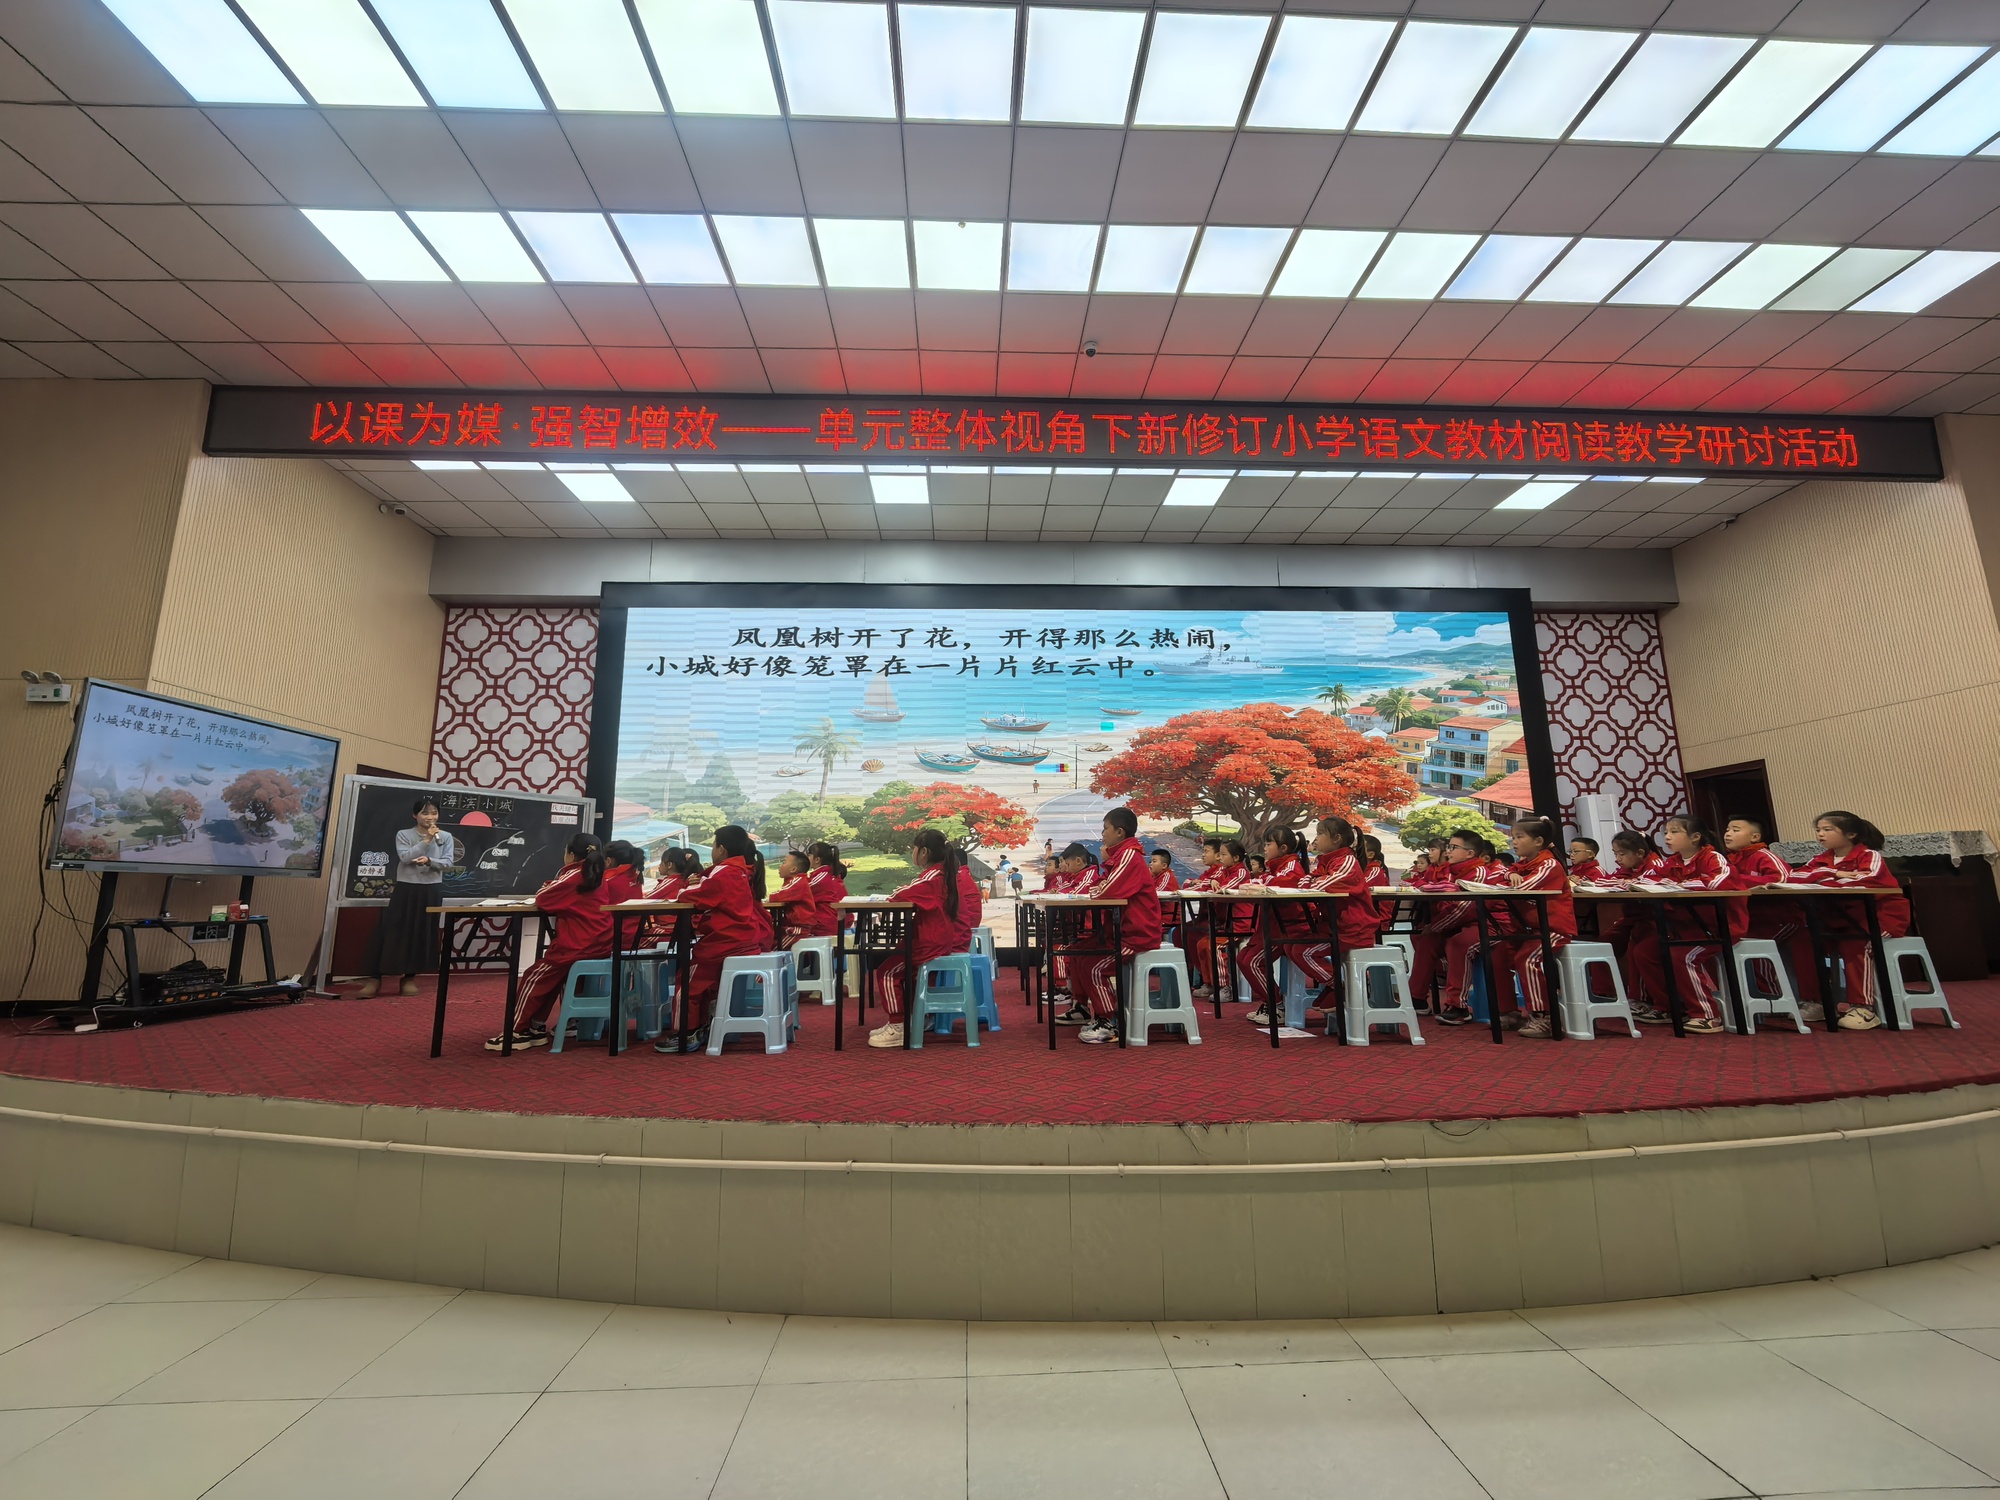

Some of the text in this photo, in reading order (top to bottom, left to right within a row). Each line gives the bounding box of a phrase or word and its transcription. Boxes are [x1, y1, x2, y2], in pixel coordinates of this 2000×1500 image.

[731, 626, 1231, 652] 凤凰树开了花，开得那么热闹，
[646, 654, 1155, 679] 小城好像笼罩在一片片红云中。
[442, 793, 512, 812] 海滨小城
